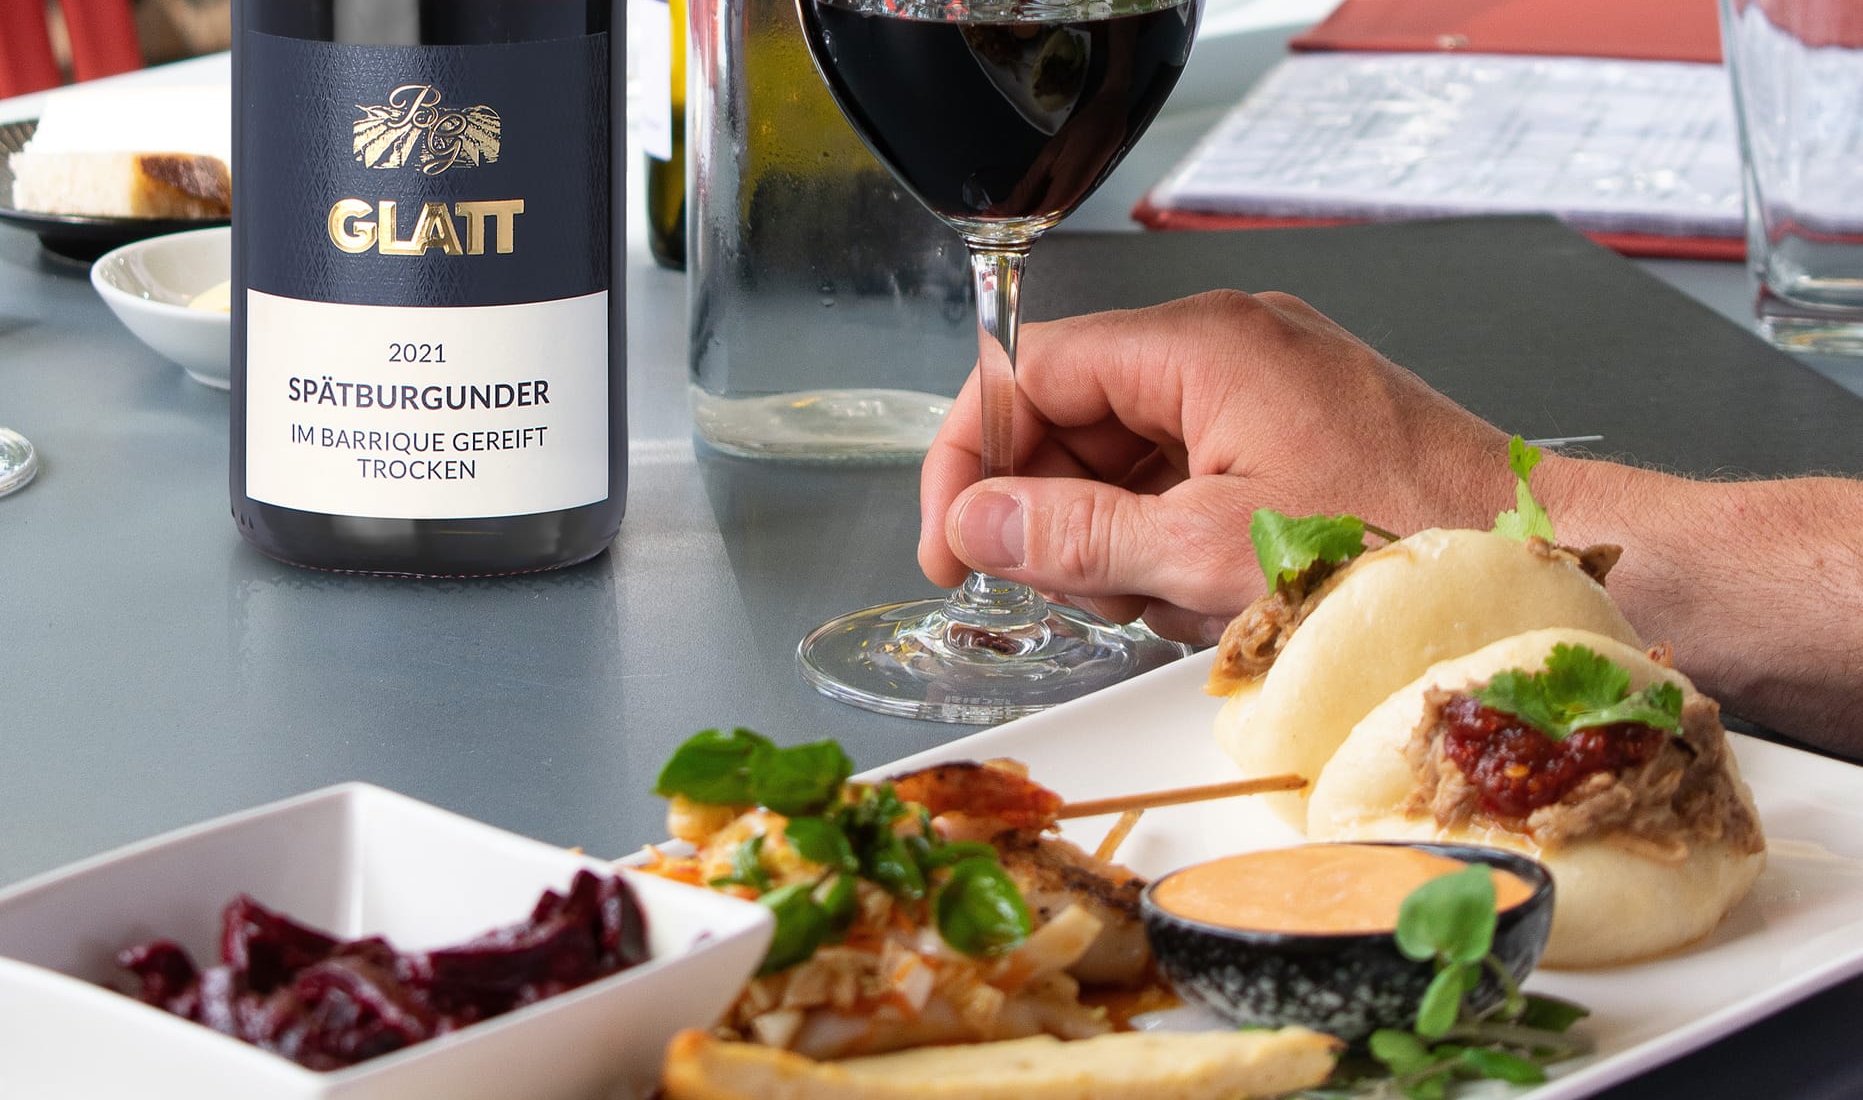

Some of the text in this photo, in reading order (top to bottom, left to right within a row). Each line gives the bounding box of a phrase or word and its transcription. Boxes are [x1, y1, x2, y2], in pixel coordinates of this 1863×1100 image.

[327, 198, 525, 256] GLATT
[389, 343, 446, 363] 2021
[288, 375, 550, 411] SPÄTBURGUNDER
[292, 423, 548, 456] IM BARRIQUE GEREIFT
[357, 458, 476, 480] TROCKEN
